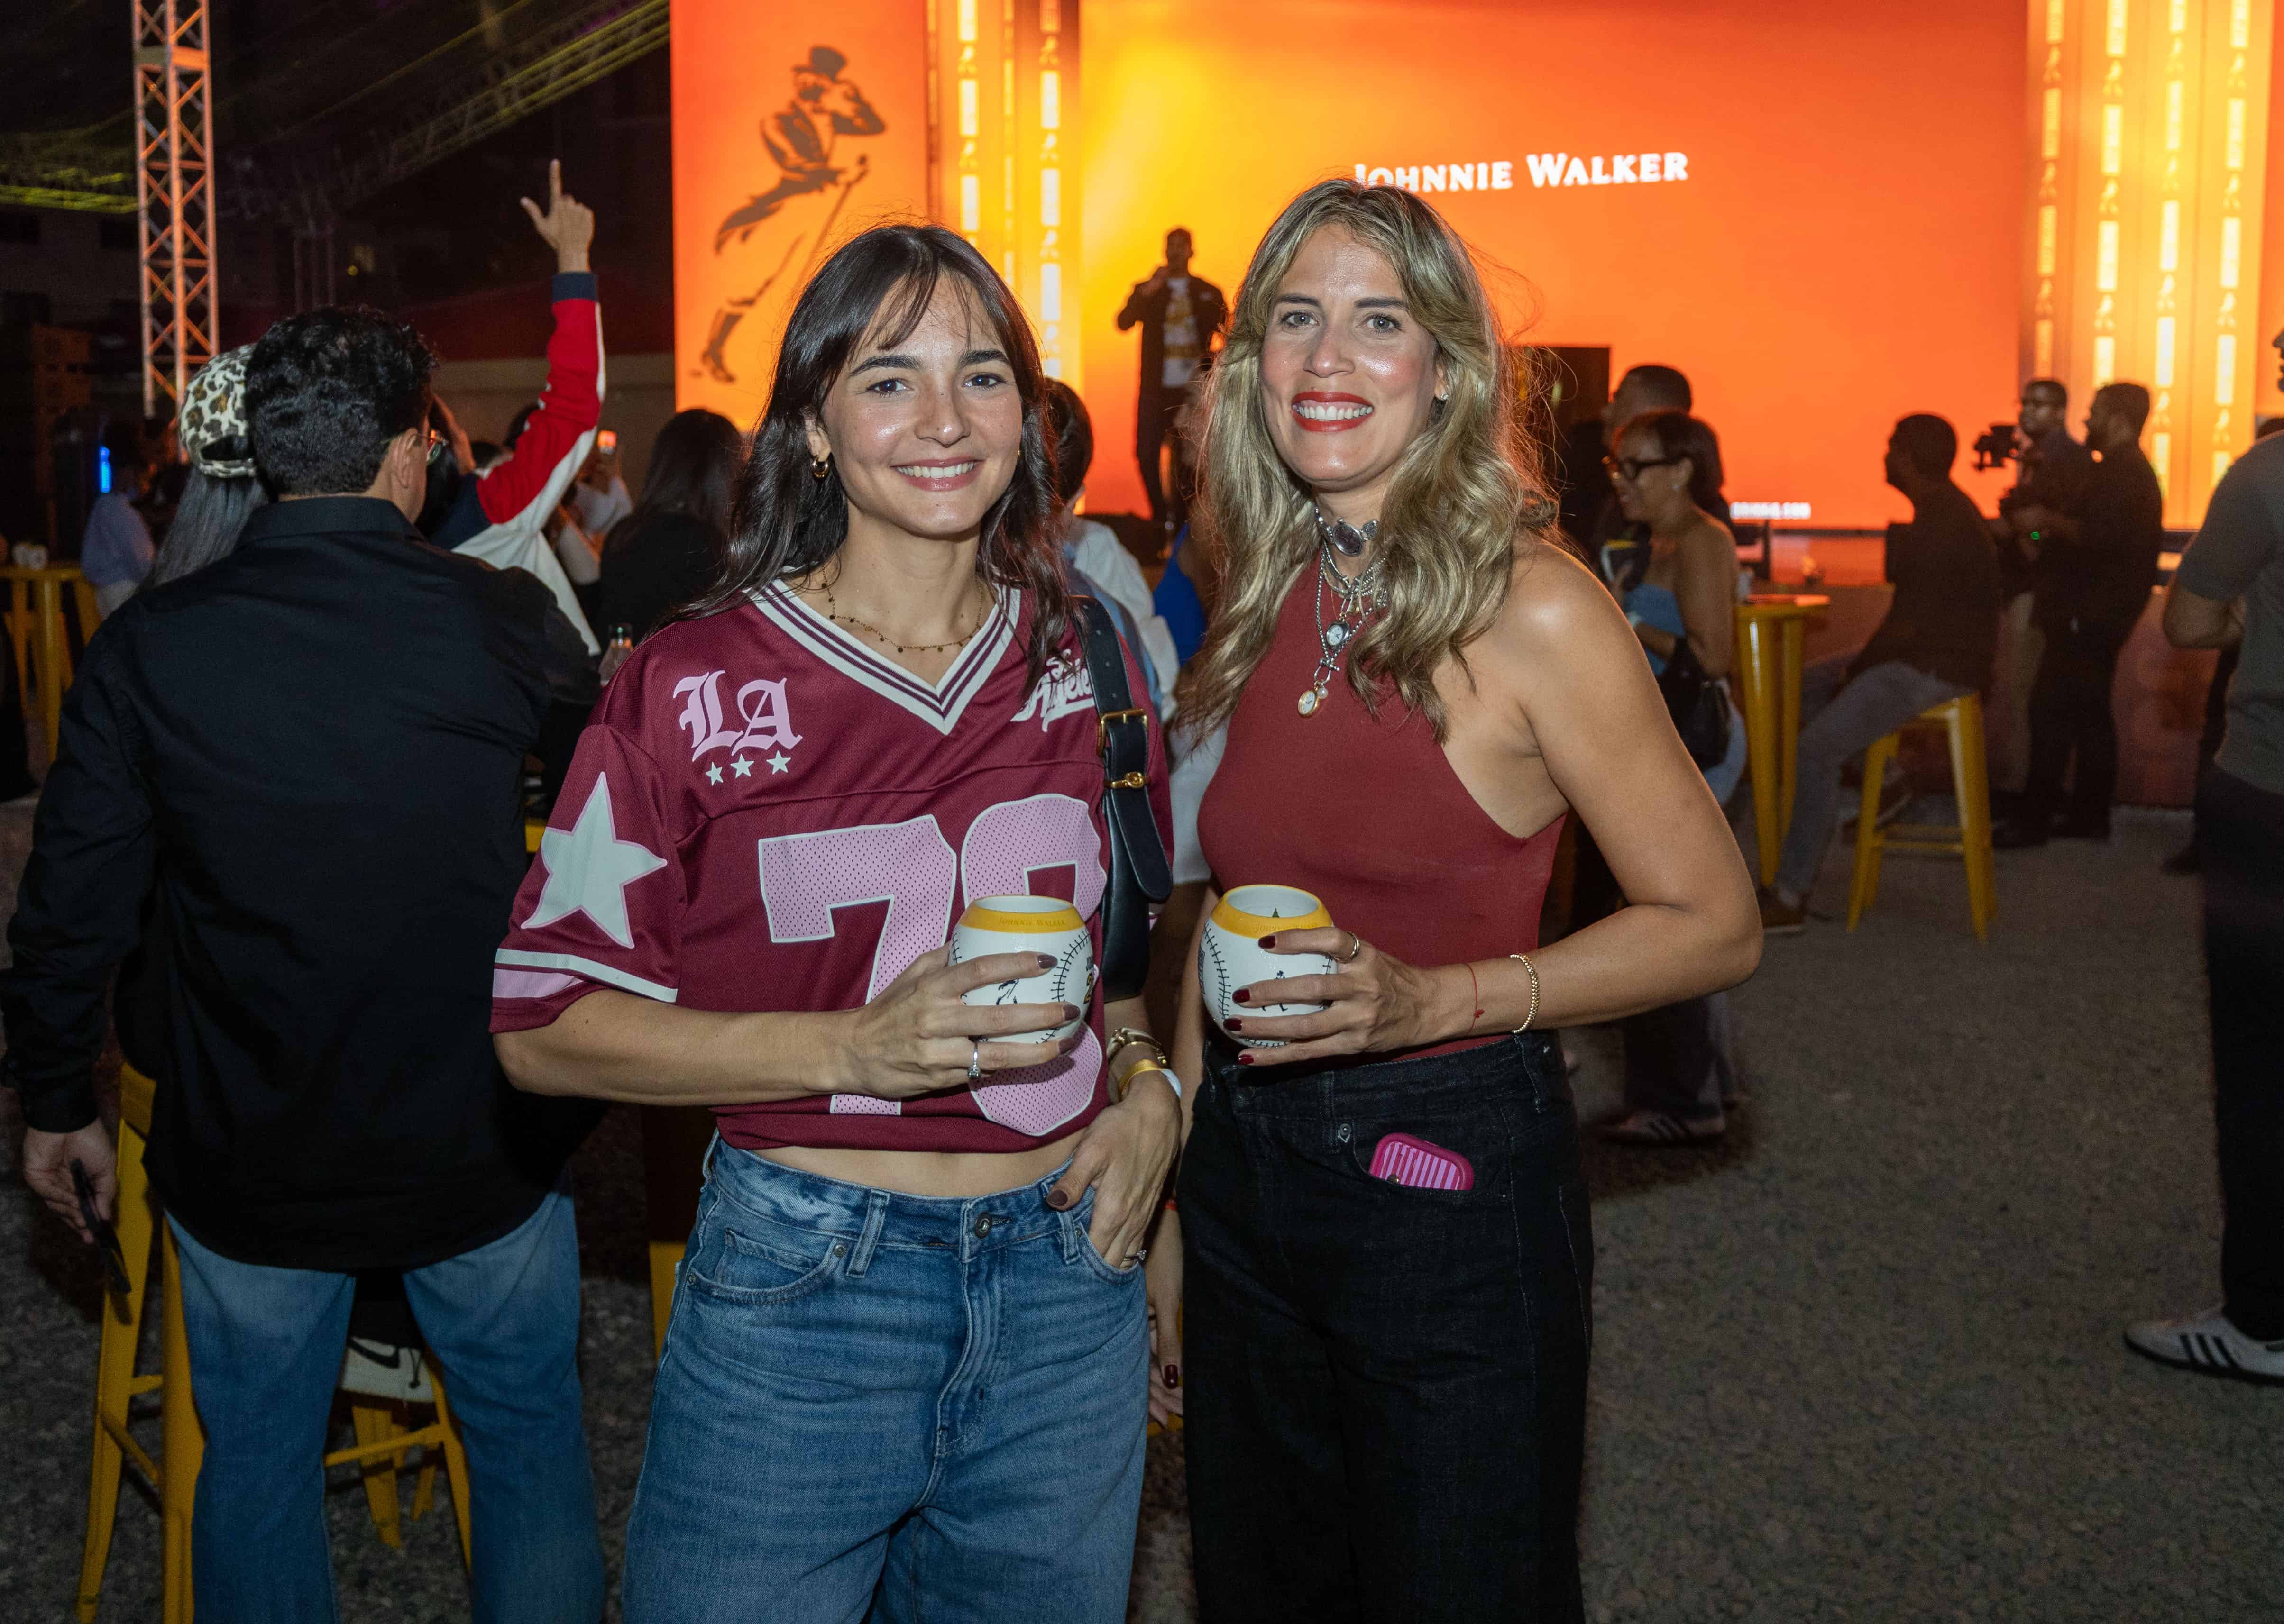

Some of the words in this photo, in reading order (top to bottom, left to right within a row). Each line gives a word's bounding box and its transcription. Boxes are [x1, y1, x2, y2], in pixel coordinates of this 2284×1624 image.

[1354, 161, 1513, 193] JOHNNIE
[1526, 152, 1688, 188] WALKER
[673, 670, 803, 762] LA
